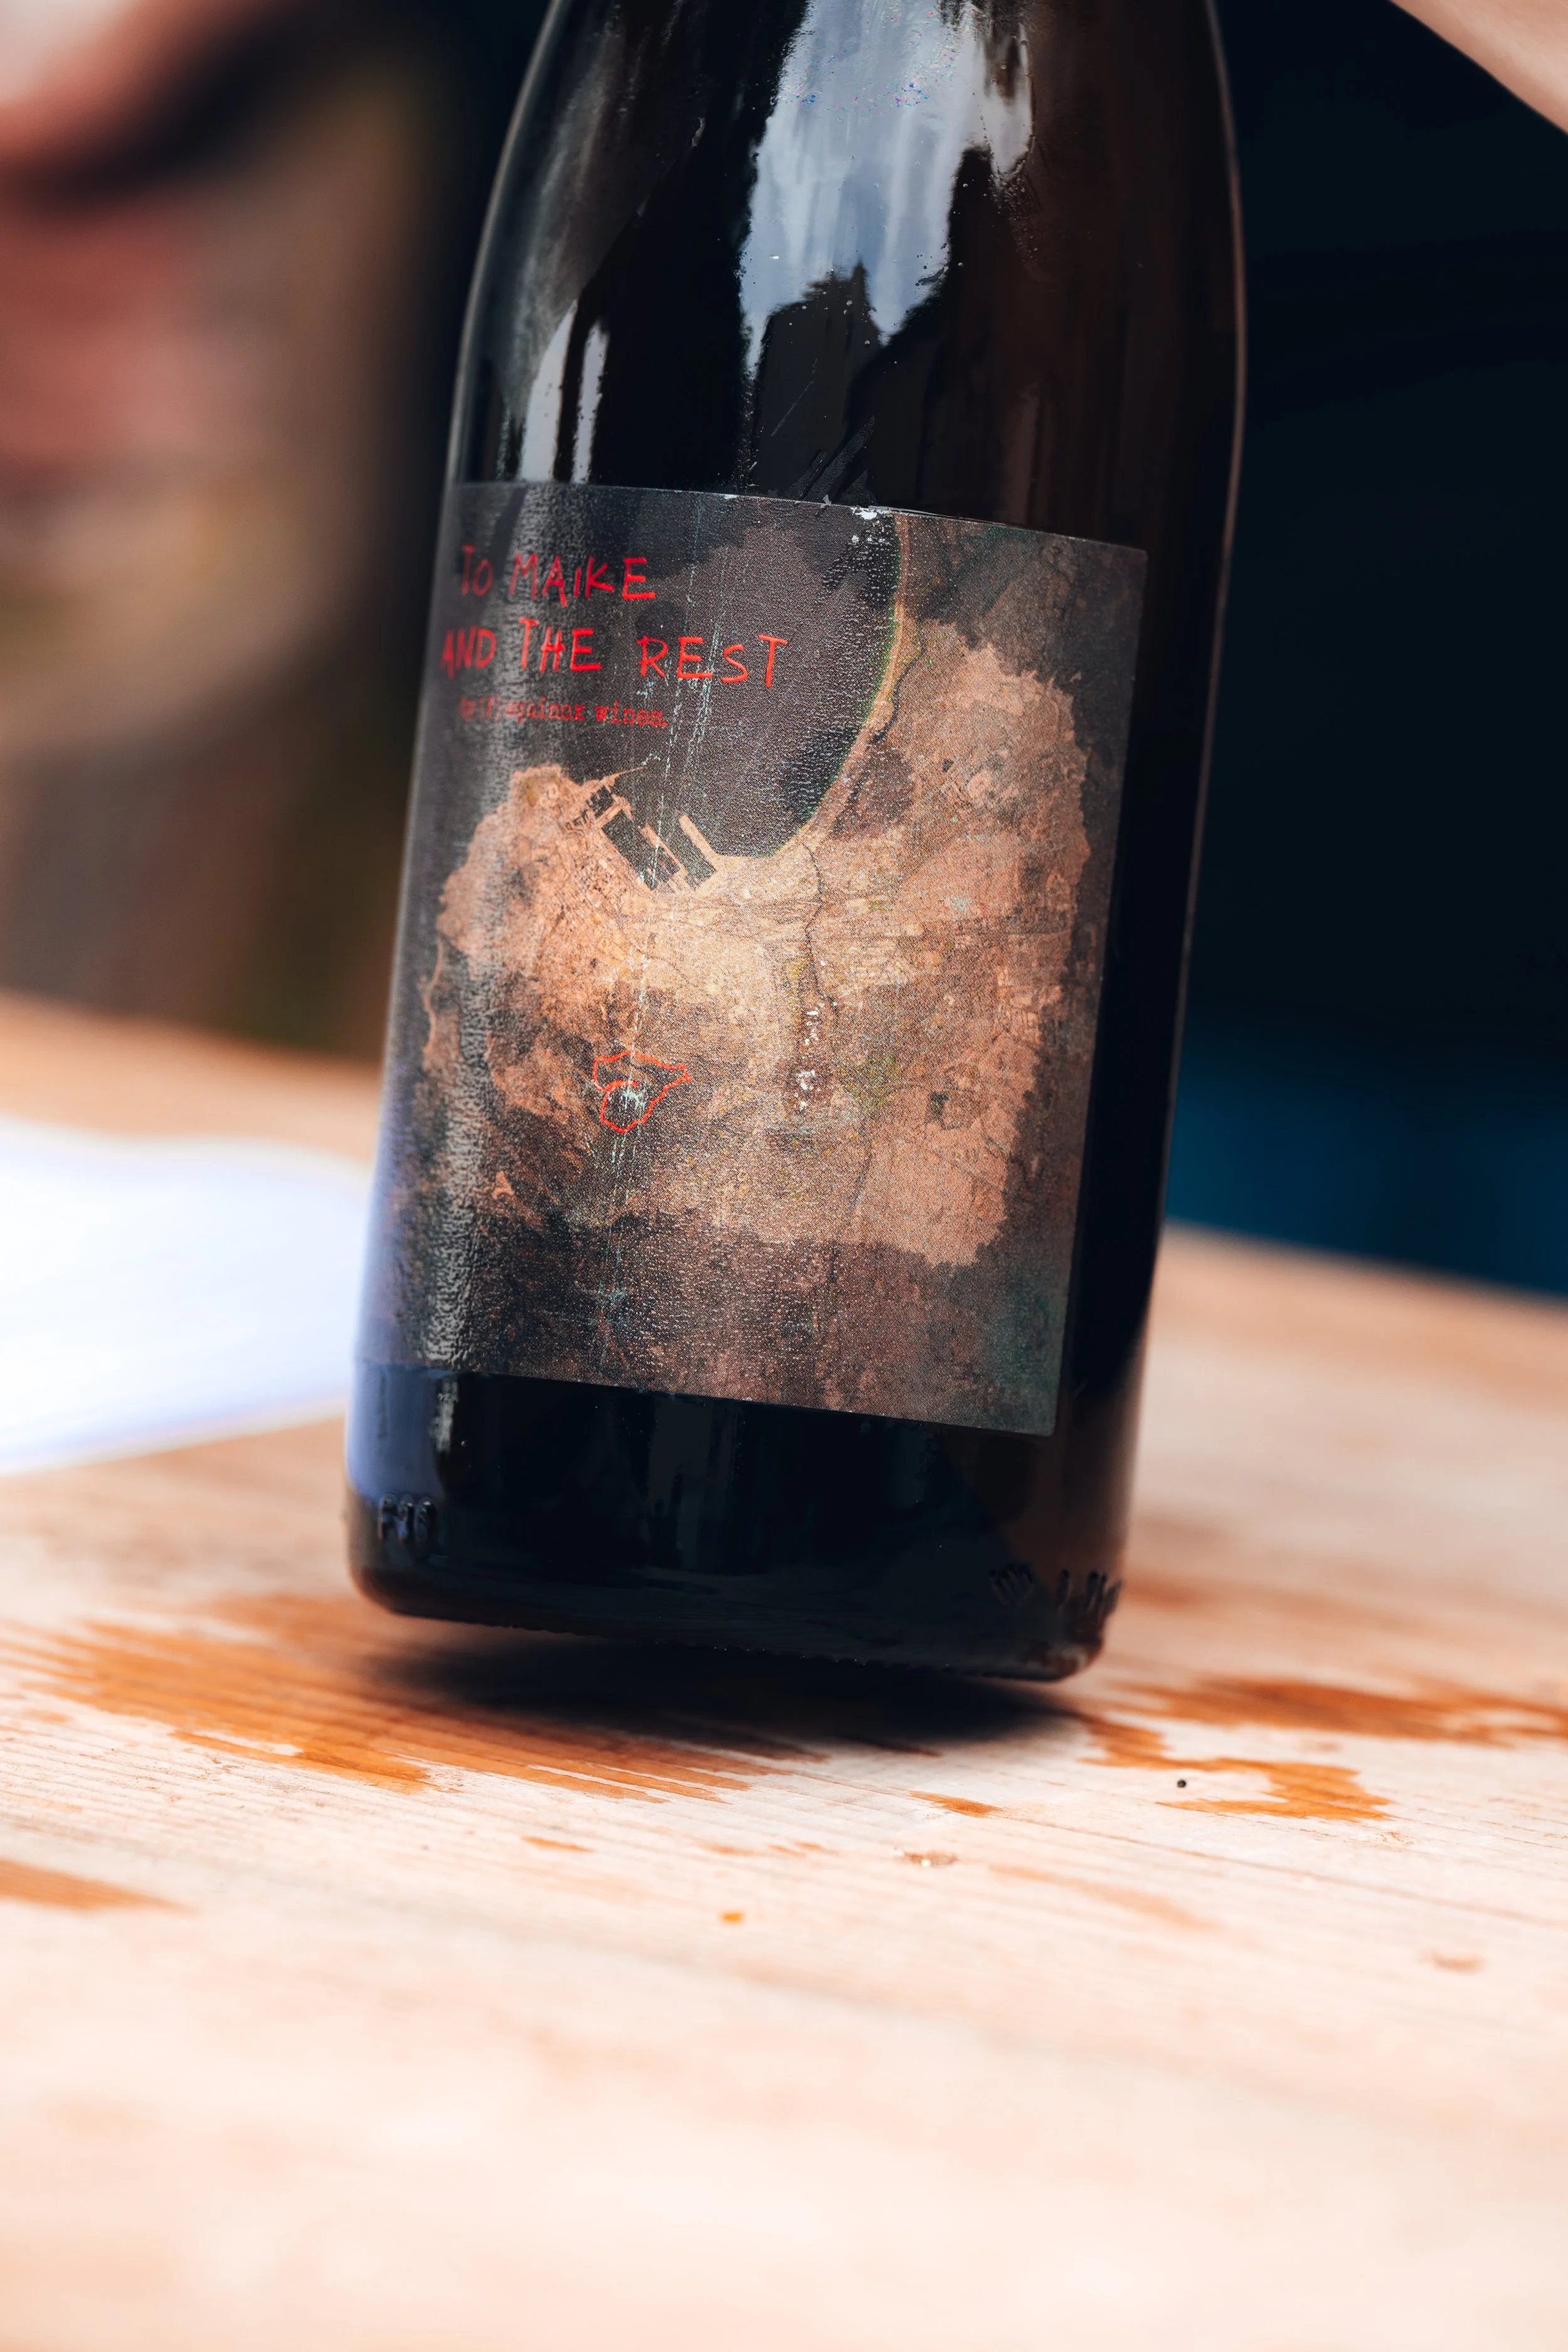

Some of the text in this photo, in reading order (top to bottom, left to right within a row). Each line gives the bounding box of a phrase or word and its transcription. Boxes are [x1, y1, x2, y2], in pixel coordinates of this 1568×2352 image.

[440, 617, 789, 689] AND THE REST
[595, 699, 669, 728] wines.
